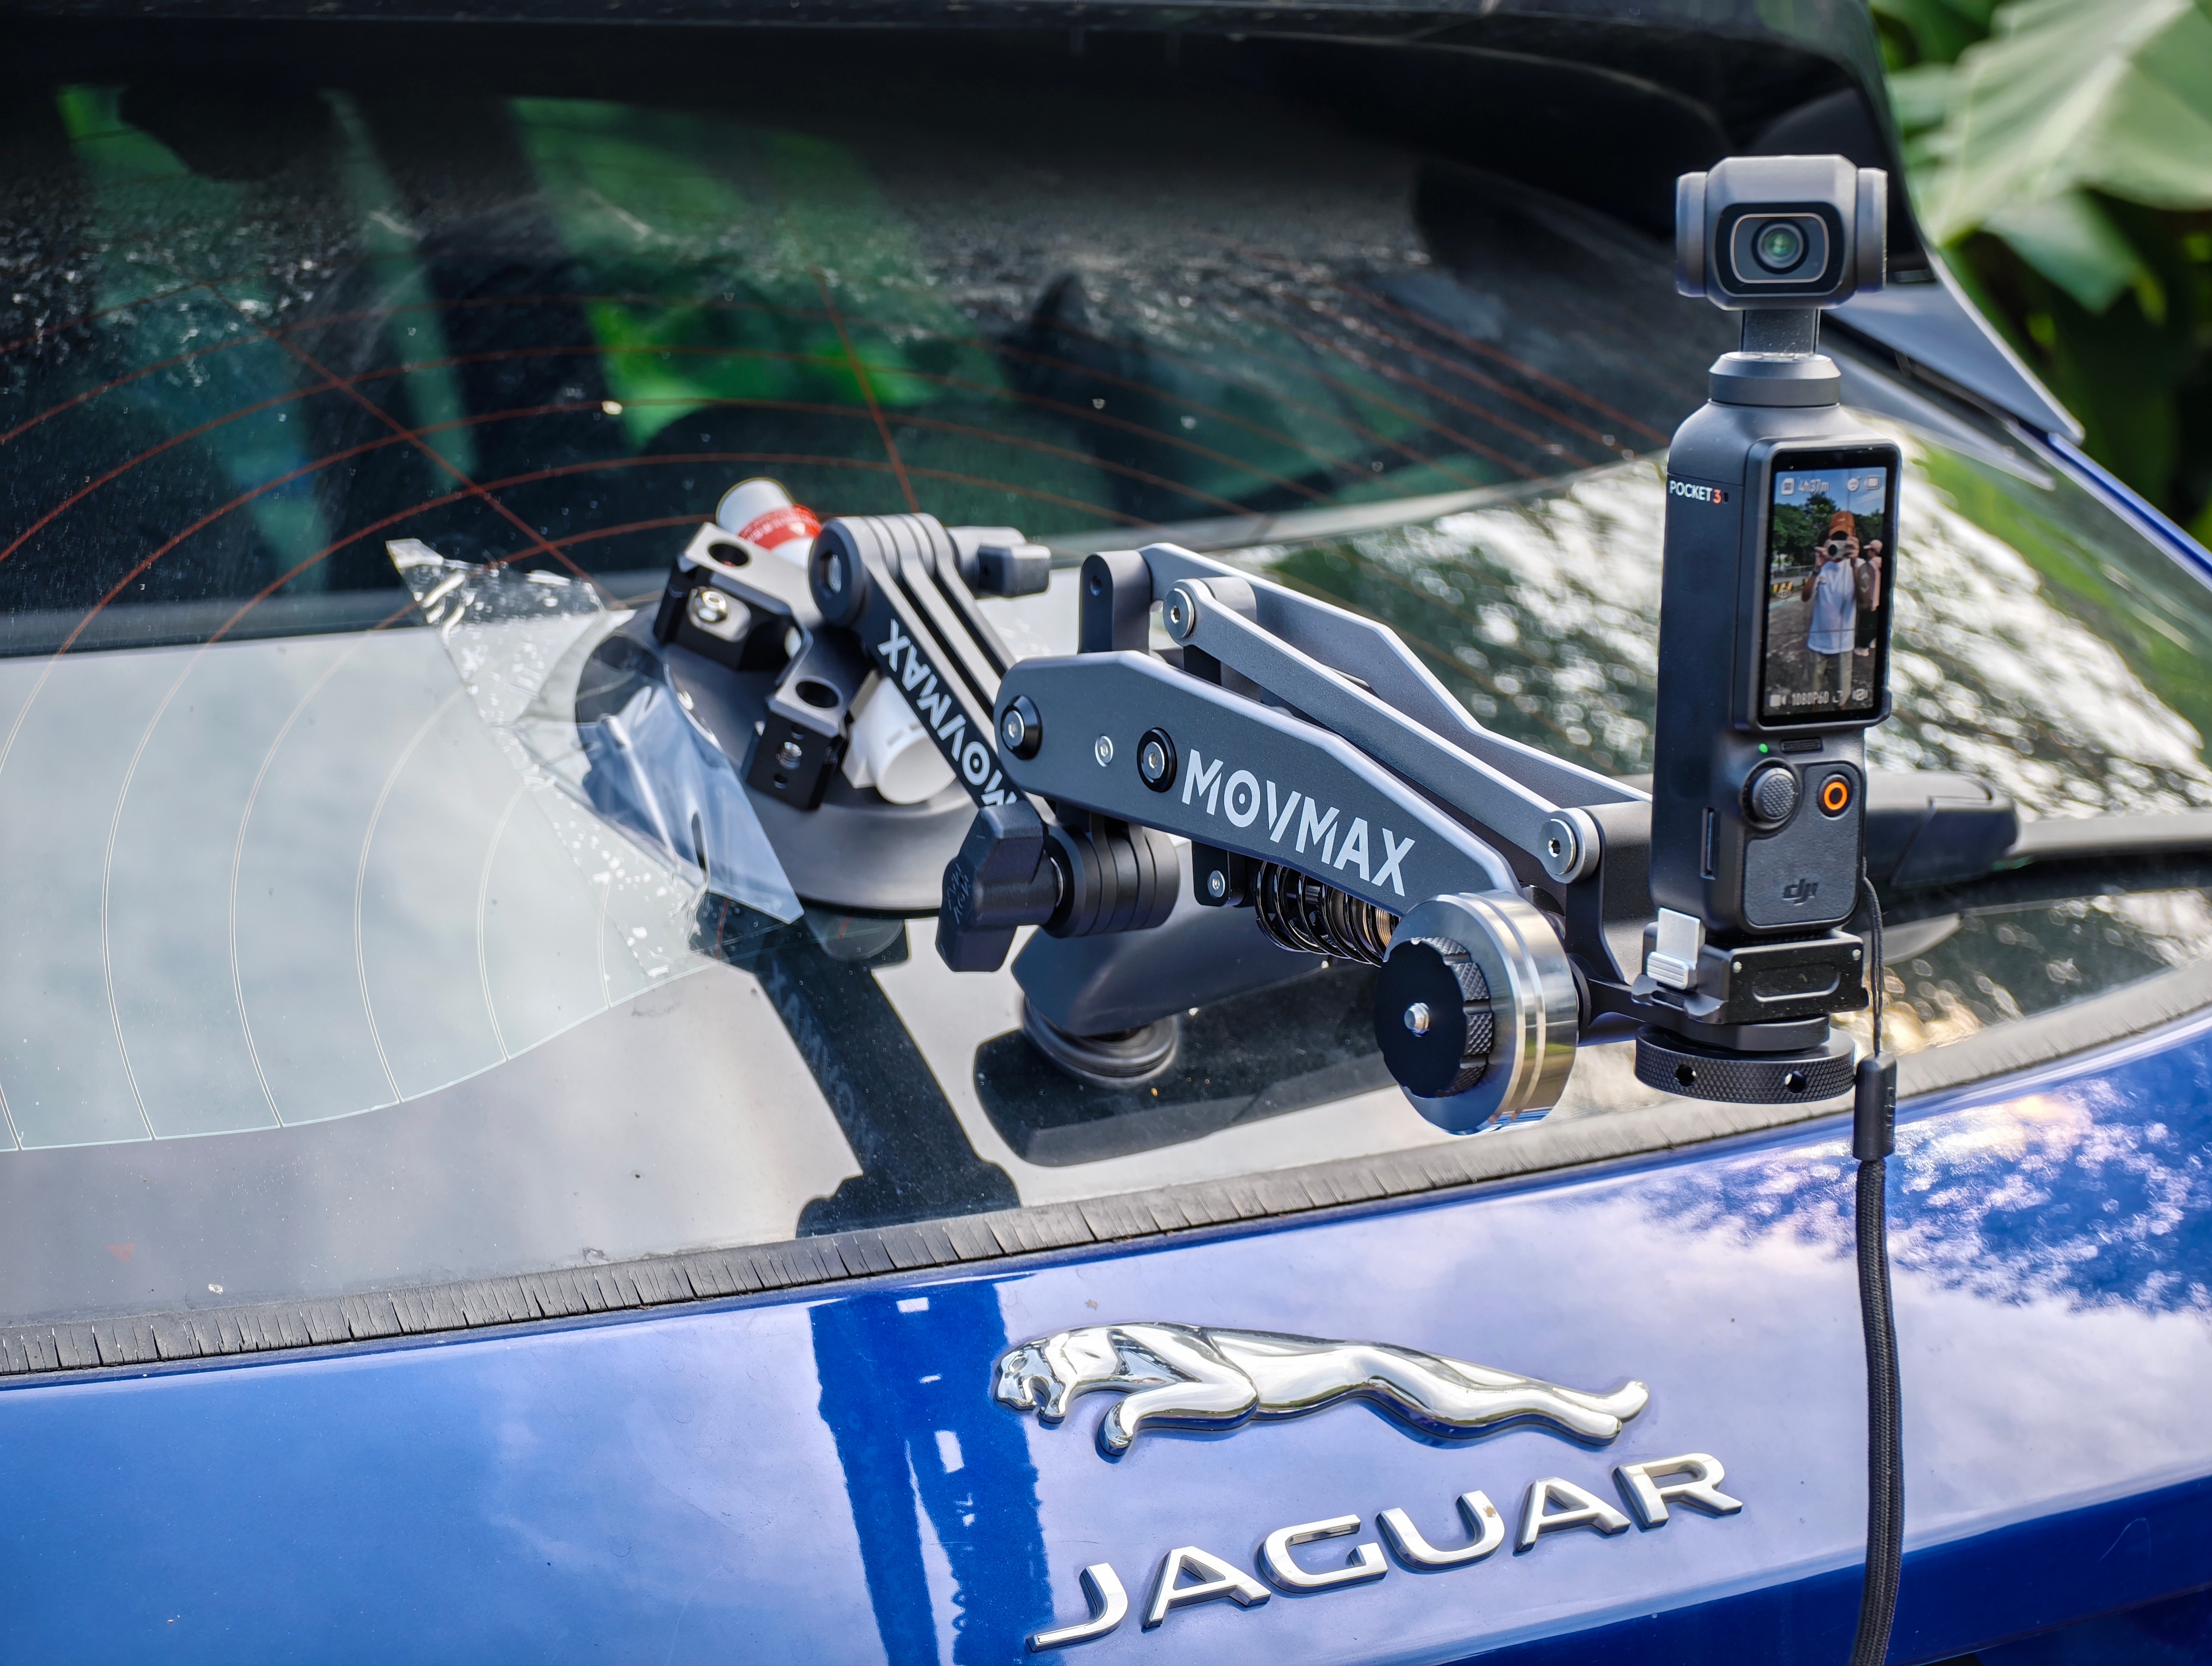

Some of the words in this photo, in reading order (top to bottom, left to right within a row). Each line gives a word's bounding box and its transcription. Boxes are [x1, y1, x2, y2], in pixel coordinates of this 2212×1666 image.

[1669, 480, 1713, 501] POCKET
[1713, 489, 1721, 504] 3
[878, 618, 1018, 807] MOVMAX
[1182, 749, 1415, 897] MOVMAX
[1026, 1452, 1742, 1652] JAGUAR
